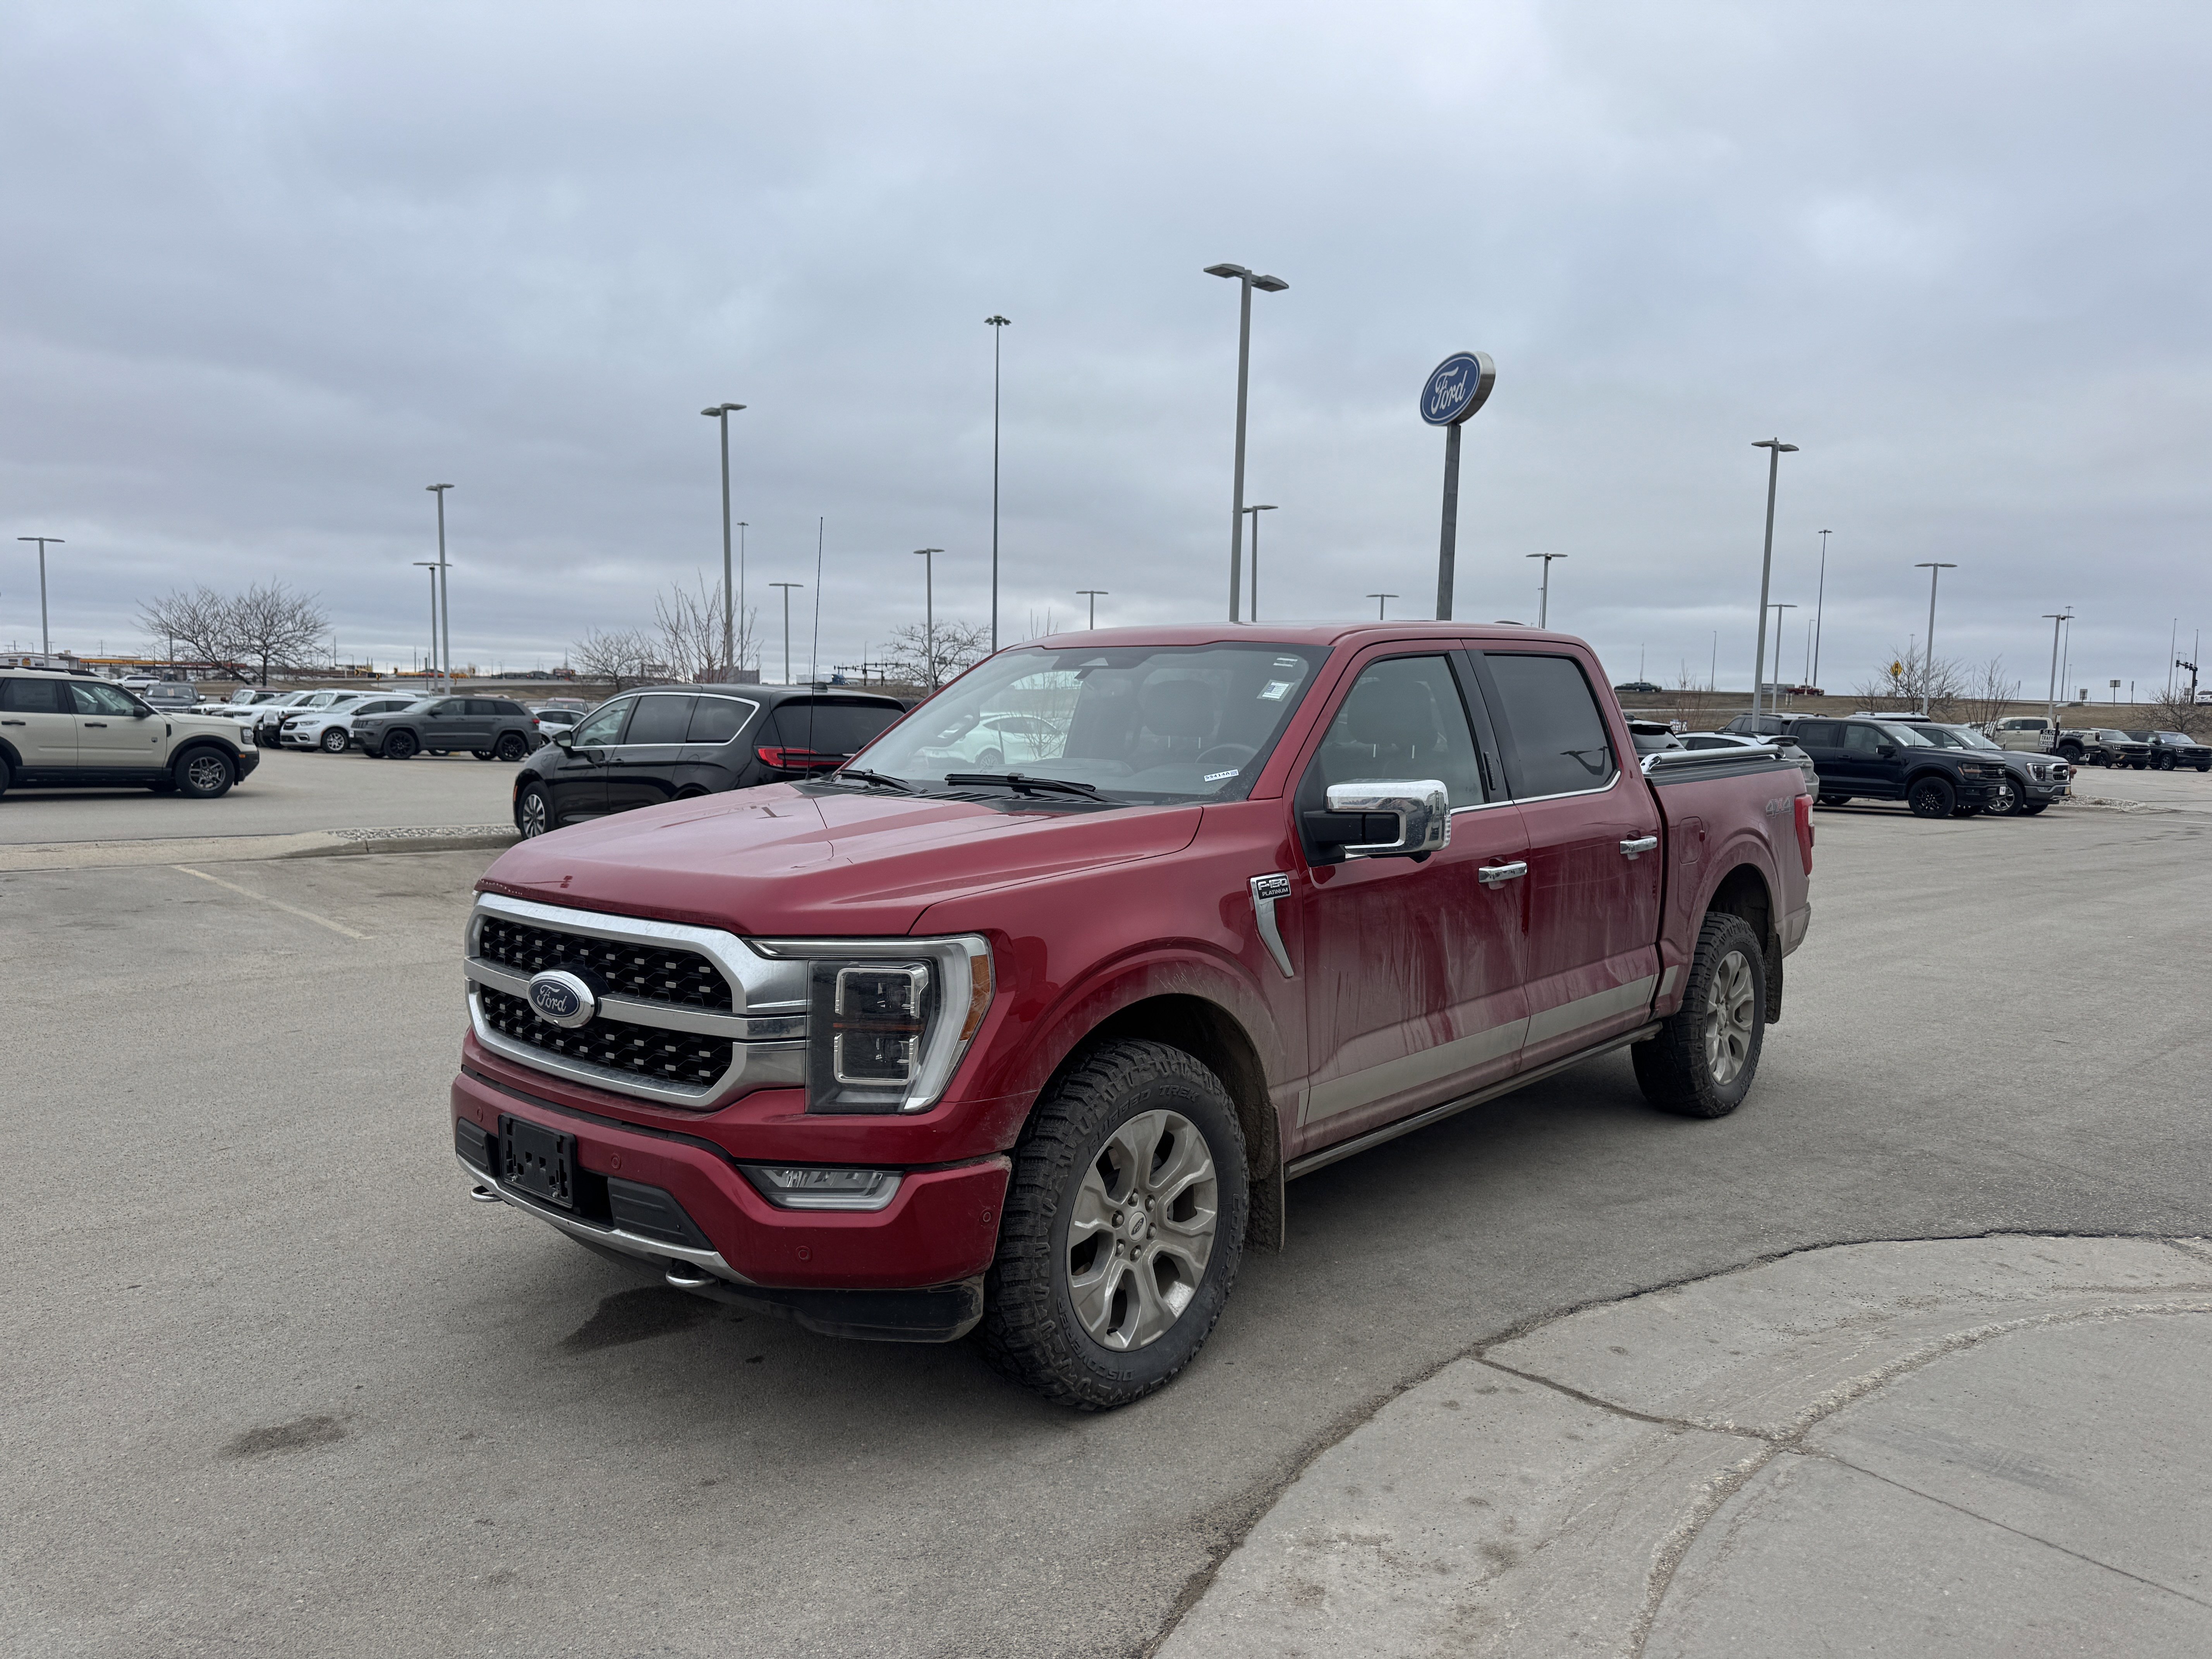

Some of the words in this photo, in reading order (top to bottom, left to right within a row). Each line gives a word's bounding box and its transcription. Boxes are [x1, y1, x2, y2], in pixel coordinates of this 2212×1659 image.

[1431, 366, 1468, 414] Ford
[1258, 878, 1288, 890] F-150
[1262, 887, 1288, 896] PLATINUM
[537, 985, 567, 1012] Ford
[1088, 1089, 1151, 1155] RUGGED
[1159, 1084, 1200, 1103] TREK
